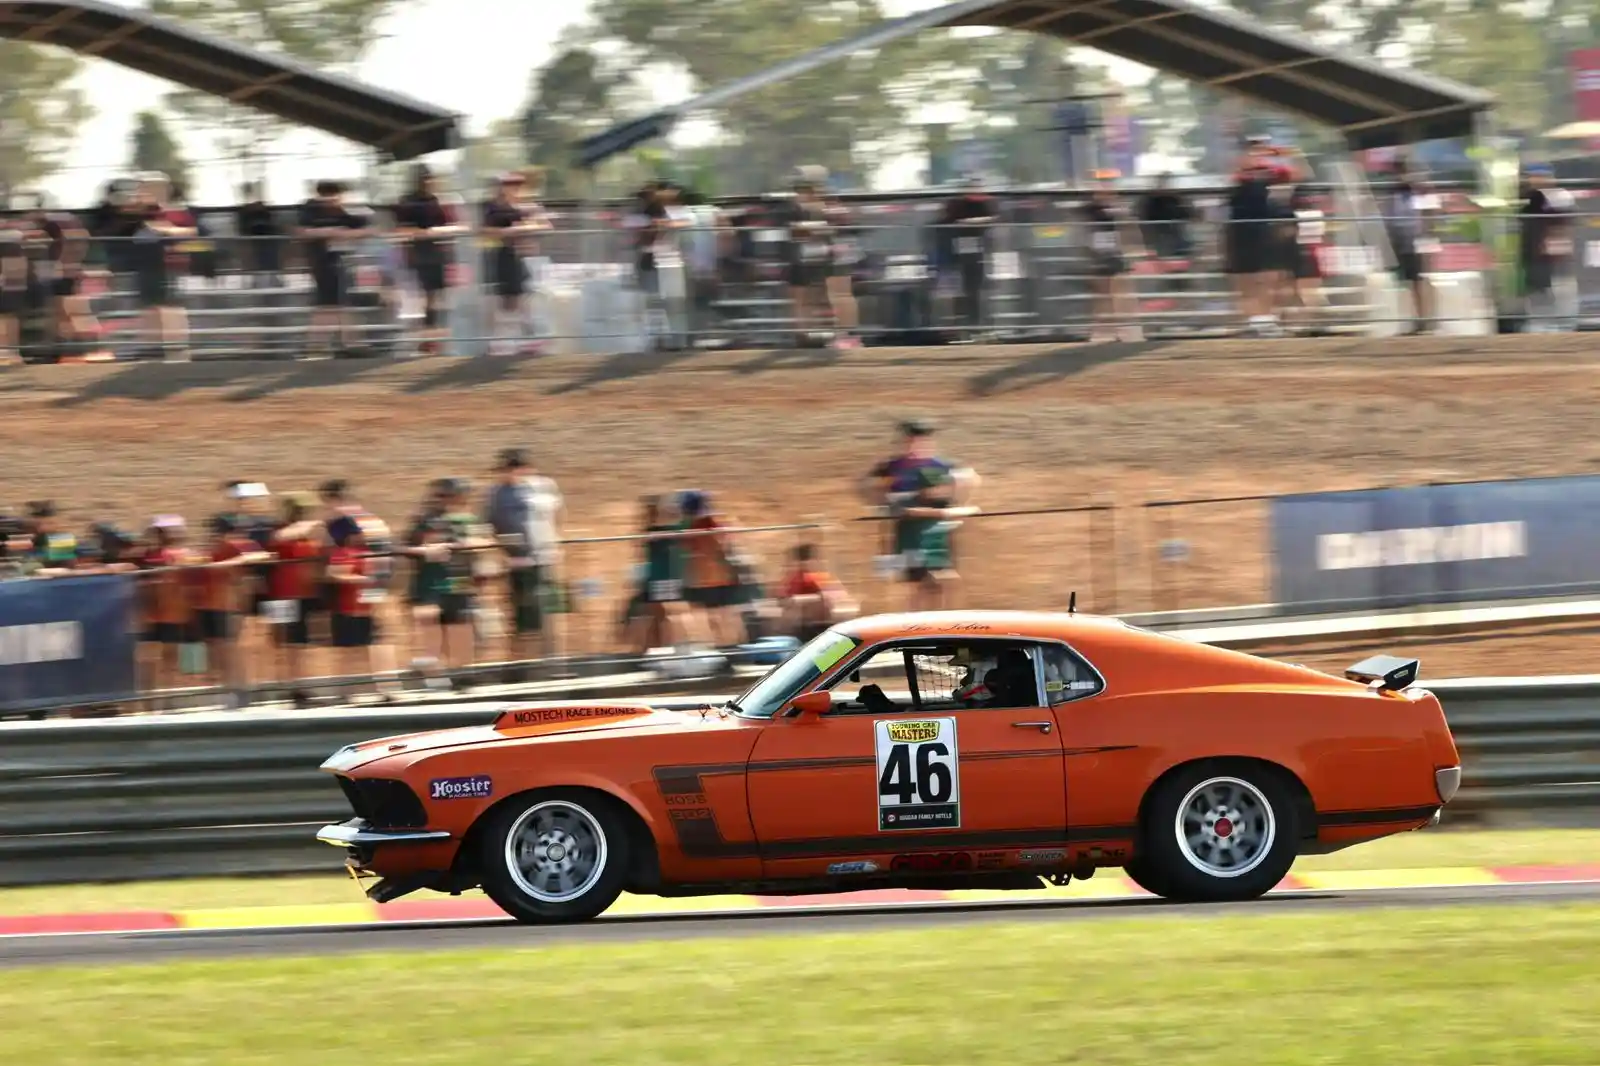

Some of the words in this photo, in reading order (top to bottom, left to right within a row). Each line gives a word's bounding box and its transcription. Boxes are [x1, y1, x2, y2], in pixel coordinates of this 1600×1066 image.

[514, 709, 562, 723] MOSTECH
[566, 708, 593, 717] RACE
[595, 707, 636, 716] ENGINES
[891, 722, 921, 730] TOURING
[891, 728, 936, 740] MASTERS
[880, 742, 952, 804] 46
[431, 778, 490, 798] Hoosier
